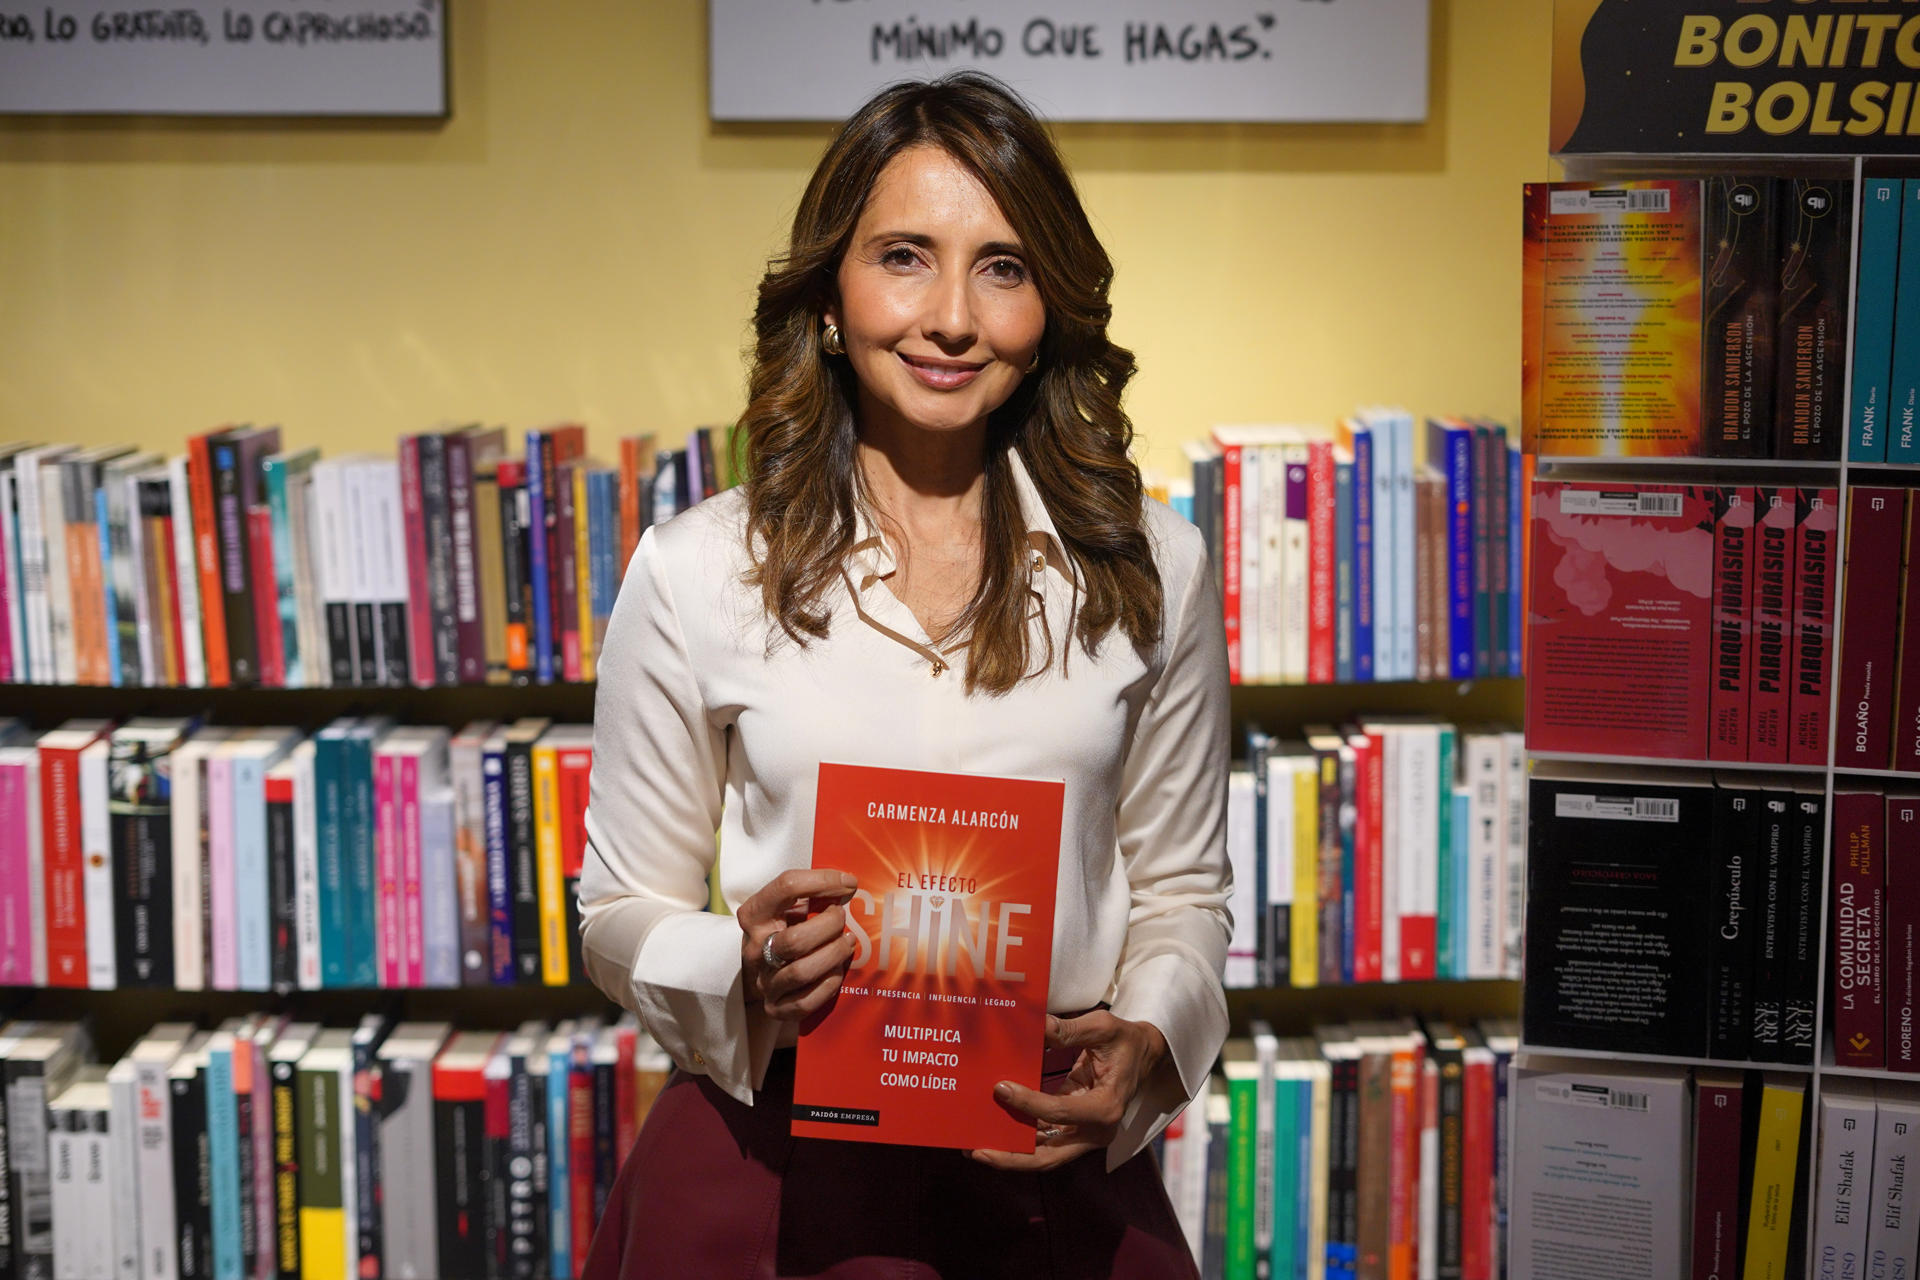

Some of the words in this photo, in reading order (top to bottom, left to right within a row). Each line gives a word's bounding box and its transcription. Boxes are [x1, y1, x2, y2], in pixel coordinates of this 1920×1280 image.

[1022, 17, 1101, 60] QUE
[1725, 322, 1742, 386] SANDERSON
[1795, 325, 1813, 389] SANDERSON
[1744, 370, 1752, 383] LA
[1816, 374, 1823, 386] LA
[1744, 386, 1752, 398] DE
[1815, 390, 1822, 402] DE
[1723, 390, 1740, 440] BRANDON
[1743, 401, 1751, 425] POZO
[1793, 393, 1810, 444] BRANDON
[1813, 404, 1821, 429] POZO
[1862, 405, 1875, 447] FRANK
[1901, 407, 1914, 448] FRANK
[1742, 427, 1750, 439] EL
[1813, 431, 1820, 444] EL
[1719, 620, 1743, 692] PARQUE
[1759, 622, 1783, 693] PARQUE
[1800, 624, 1824, 696] PARQUE
[1856, 701, 1869, 753] BOLAÑO
[866, 801, 946, 825] CARMENZA
[951, 808, 1020, 830] ALARCÓN
[1769, 823, 1780, 866] VAMPIRO
[1801, 824, 1813, 867] VAMPIRO
[1850, 832, 1859, 867] PHILIP
[1860, 824, 1871, 875] PULLMAN
[897, 872, 914, 889] EL
[920, 874, 977, 894] EFECTO
[1769, 868, 1778, 879] EL
[1801, 868, 1810, 880] EL
[1721, 855, 1747, 940] Crepúsculo
[1768, 880, 1777, 901] CON
[1800, 881, 1810, 902] CON
[843, 888, 1032, 982] SHINE
[1766, 903, 1777, 959] ENTREVISTA
[1798, 904, 1809, 961] ENTREVISTA
[1840, 882, 1855, 990] COMUNIDAD
[1856, 907, 1871, 986] SECRETA
[1874, 940, 1881, 952] LA
[1874, 953, 1881, 964] DE
[840, 986, 869, 996] SENCIA
[876, 989, 921, 1000] PRESENCIA
[928, 993, 977, 1005] INFLUENCIA
[984, 998, 1016, 1008] LEGADO
[1719, 965, 1729, 1040] STEPHENIE
[1732, 982, 1742, 1026] MEYER
[1843, 993, 1854, 1010] LA
[1874, 993, 1881, 1004] EL
[884, 1024, 961, 1044] MULTIPLICA
[1901, 1007, 1912, 1061] MORENO
[882, 1048, 899, 1063] TU
[902, 1049, 959, 1067] IMPACTO
[880, 1072, 919, 1088] COMO
[921, 1071, 957, 1091] LÍDER
[810, 1110, 838, 1119] PAIDÓS
[840, 1113, 875, 1121] EMPRESA
[1837, 1150, 1855, 1197] Shafak
[1888, 1154, 1905, 1202] Shafak
[1835, 1199, 1851, 1225] Elif
[1885, 1203, 1901, 1229] Elif
[1871, 1250, 1887, 1280] CTO
